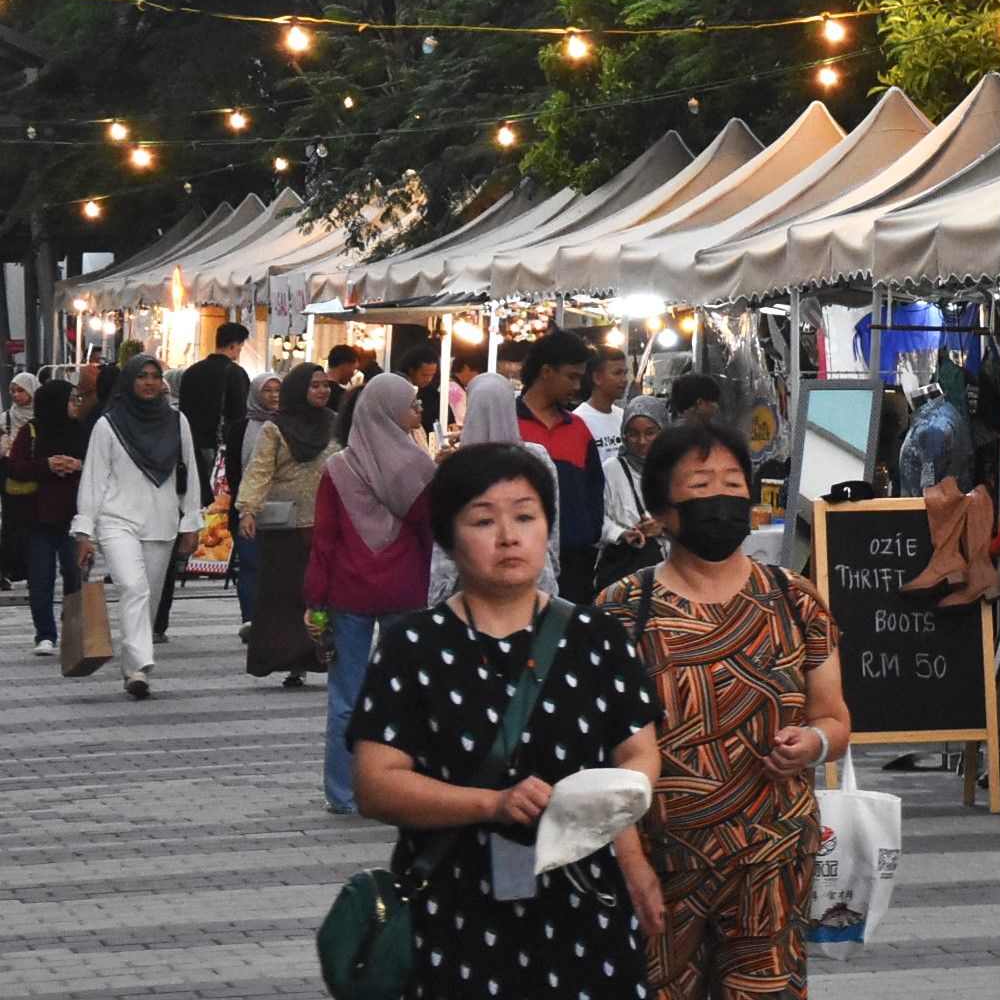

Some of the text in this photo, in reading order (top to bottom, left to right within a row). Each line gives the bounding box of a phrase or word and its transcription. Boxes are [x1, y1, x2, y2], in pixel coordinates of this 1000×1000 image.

[834, 564, 907, 593] THRIFT
[874, 609, 936, 634] BOOTS
[861, 650, 947, 679] RM 50
